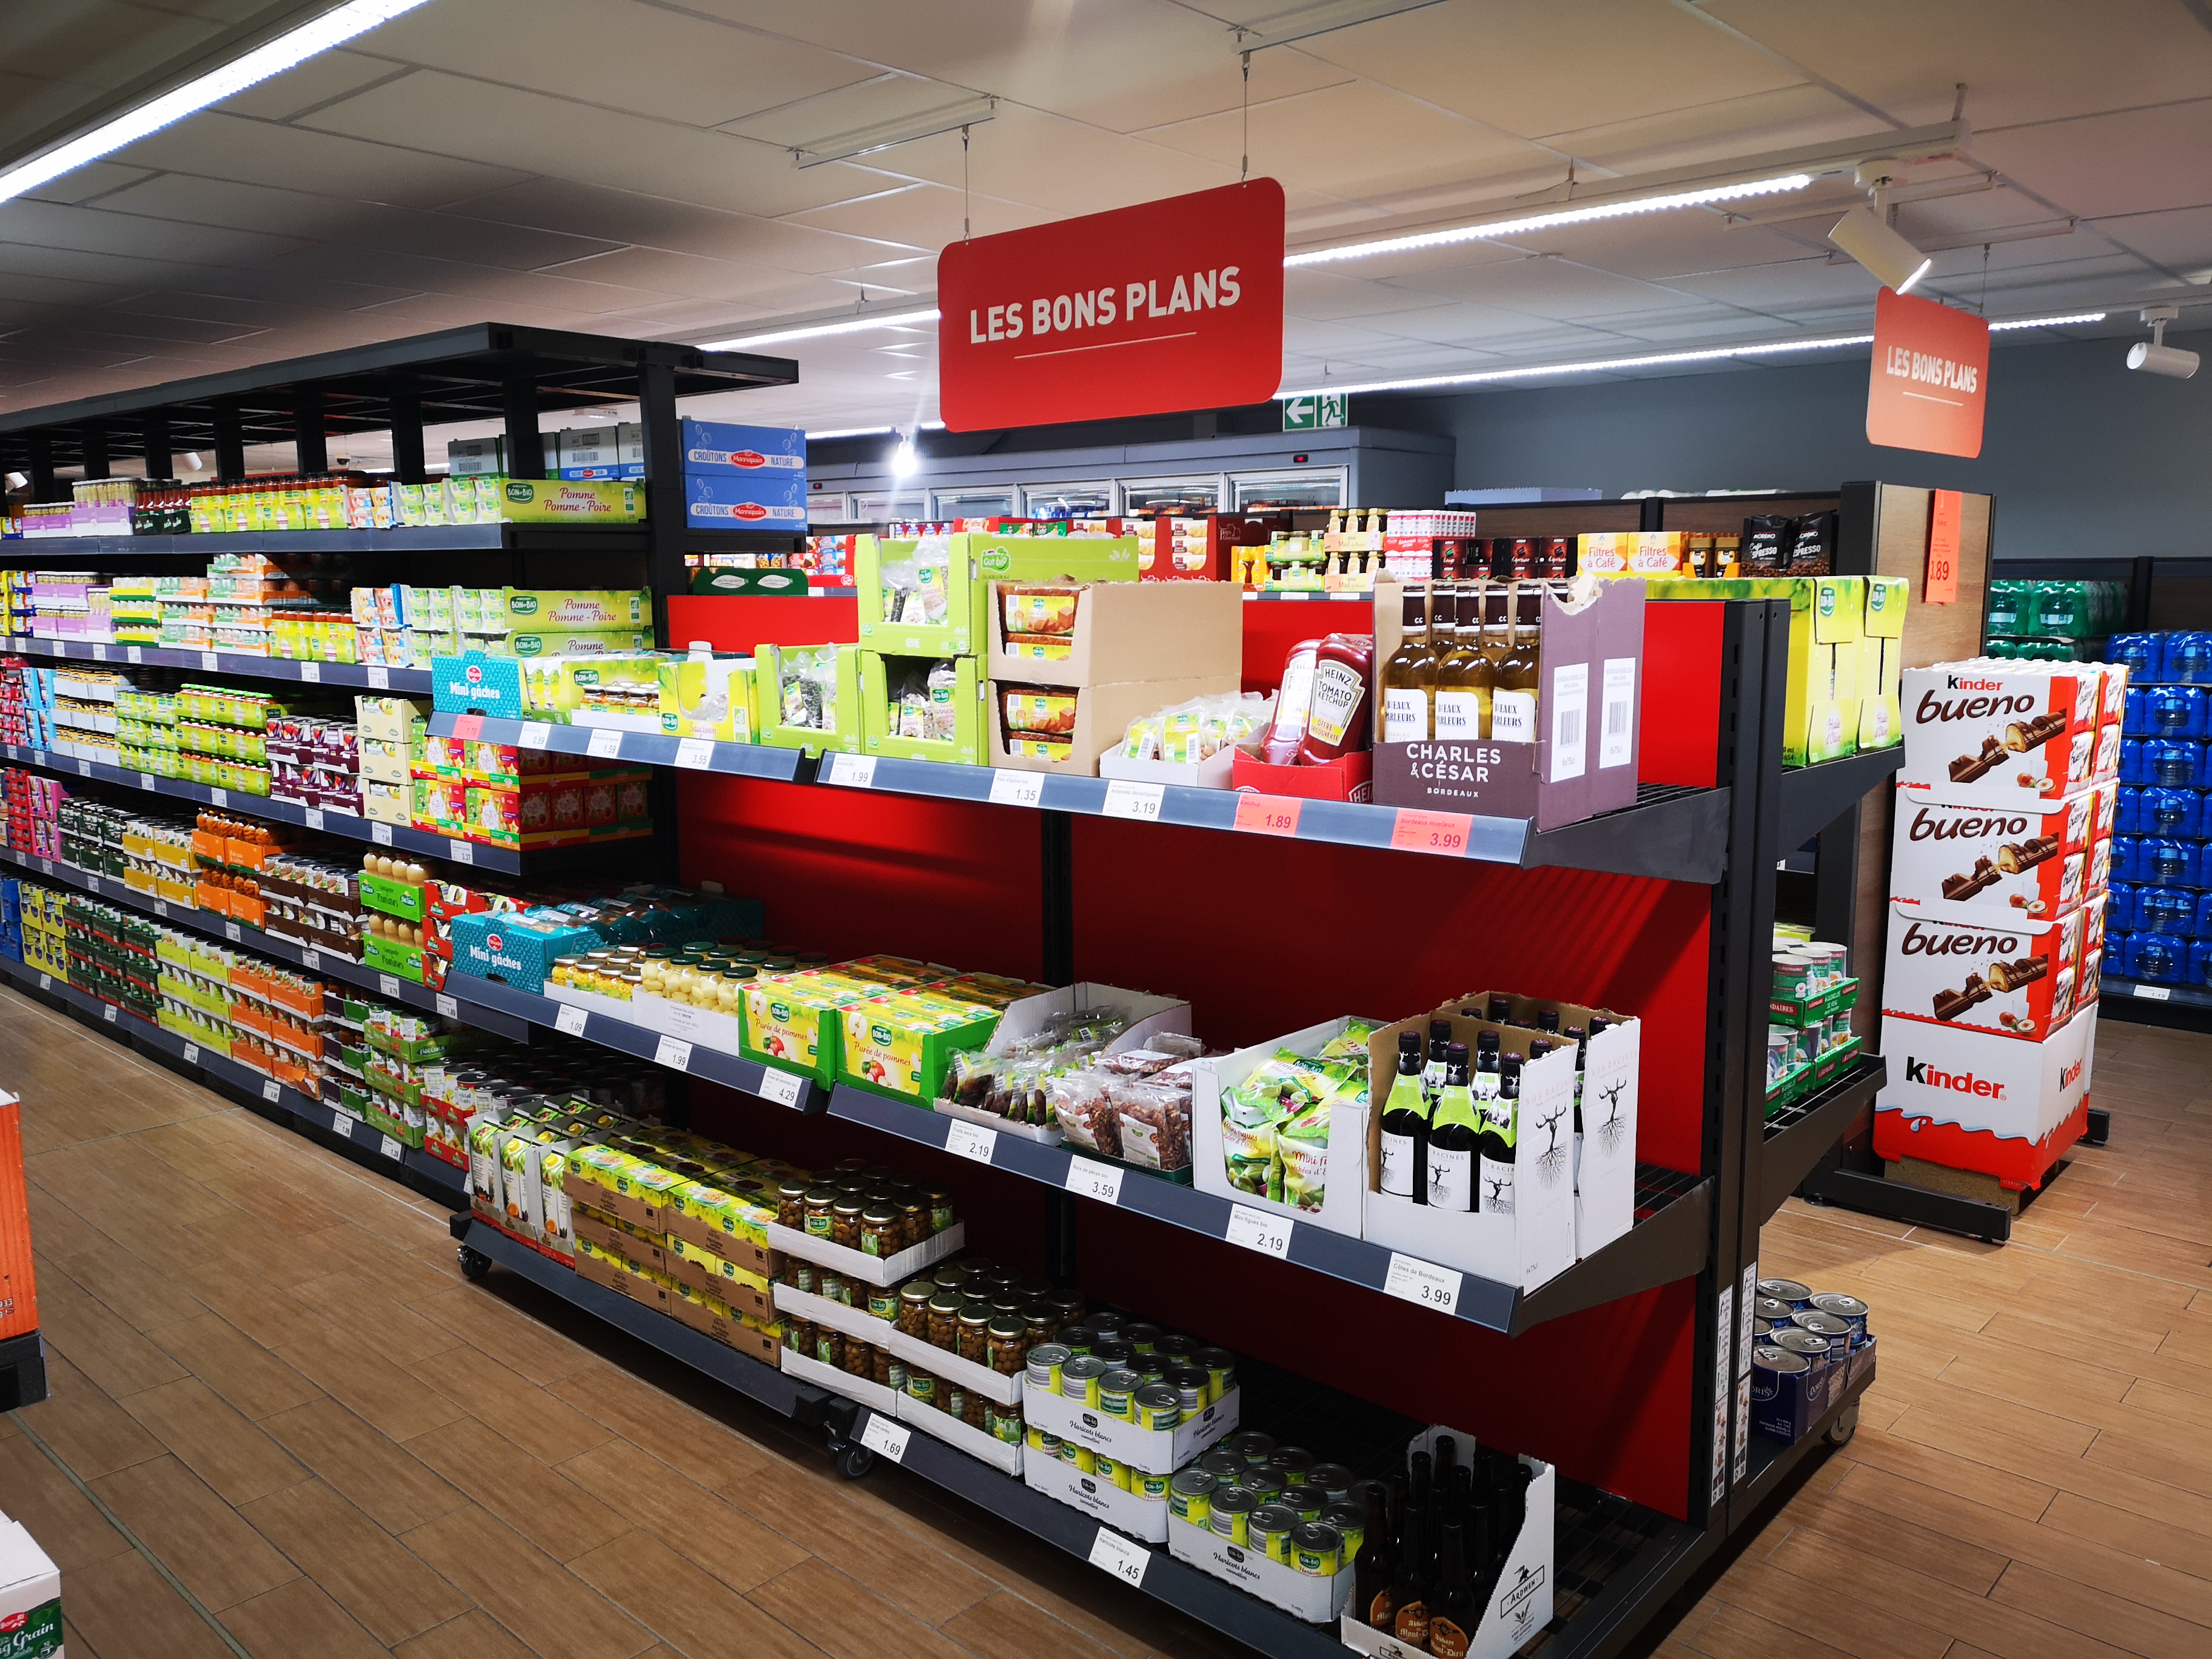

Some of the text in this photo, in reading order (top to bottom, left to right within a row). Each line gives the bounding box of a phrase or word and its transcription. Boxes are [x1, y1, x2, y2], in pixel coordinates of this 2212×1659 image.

[971, 266, 1241, 344] LES BONS PLANS
[1886, 346, 1978, 394] LES BONS PLANS
[694, 449, 726, 463] CROÛTONS
[771, 457, 794, 467] NATURE
[560, 487, 595, 500] Pomme
[543, 499, 611, 512] Pomme Poire
[696, 503, 729, 515] CROÛTONS
[773, 509, 795, 518] NATURE
[1589, 547, 1614, 556] Filtres
[1640, 546, 1666, 556] Filtres
[1596, 558, 1615, 568] Café
[1646, 557, 1667, 567] Café
[565, 598, 600, 609] Pomme
[548, 610, 616, 622] Pomme Poire
[568, 640, 603, 651] Pomme
[1325, 668, 1352, 686] HEINZ
[1948, 675, 2003, 691] Kinder
[450, 681, 500, 700] Mini gâches
[1319, 680, 1352, 701] TOMATO
[1318, 692, 1348, 708] KETCHUP
[1916, 689, 2034, 723] bueno
[689, 722, 717, 734] Saucisson
[1317, 719, 1333, 732] OFFRE
[533, 736, 545, 745] 0.89
[604, 745, 616, 754] 1.59
[1406, 743, 1501, 765] CHARLES
[692, 754, 706, 764] 3.55
[851, 771, 868, 782] 1.99
[1016, 789, 1036, 801] 1.35
[1354, 785, 1373, 802] HEI
[1427, 787, 1479, 798] BORDEAUX
[1133, 801, 1156, 814] 3.19
[1265, 814, 1291, 828] 1.89
[1910, 808, 2027, 841] bueno
[1430, 833, 1461, 848] 3.99
[1902, 922, 2018, 956] bueno
[470, 944, 521, 970] Mini gâches
[570, 1021, 582, 1031] 1.09
[756, 1018, 807, 1040] Purée de pommes
[672, 1054, 686, 1066] 1.99
[854, 1042, 910, 1066] Purée de pommes
[1906, 1056, 2005, 1099] Kinder
[2060, 1058, 2082, 1093] Kinder
[779, 1088, 795, 1102] 4.29
[970, 1142, 990, 1158] 2.19
[1292, 1150, 1317, 1164] Mini
[1433, 1150, 1464, 1160] RACINES
[1093, 1181, 1114, 1198] 3.59
[1245, 1216, 1259, 1225] figues
[1257, 1233, 1282, 1250] 2.19
[1393, 1263, 1409, 1273] Côtes
[1418, 1270, 1445, 1284] Bordeaux
[1421, 1285, 1451, 1305] 3.99
[1070, 1421, 1093, 1435] Haricots
[1095, 1431, 1111, 1443] blancs
[883, 1439, 900, 1455] 1.69
[1068, 1485, 1092, 1500] Haricots
[1093, 1497, 1109, 1509] blancs
[1099, 1537, 1115, 1550] Haricots
[1118, 1560, 1140, 1580] 1.45
[1213, 1552, 1240, 1570] Haricots
[1241, 1566, 1260, 1580] blancs
[1298, 1566, 1321, 1576] Haricots
[1510, 1579, 1535, 1604] ARDWEN
[13, 1623, 54, 1650] Grain
[1435, 1634, 1454, 1646] Abbaye
